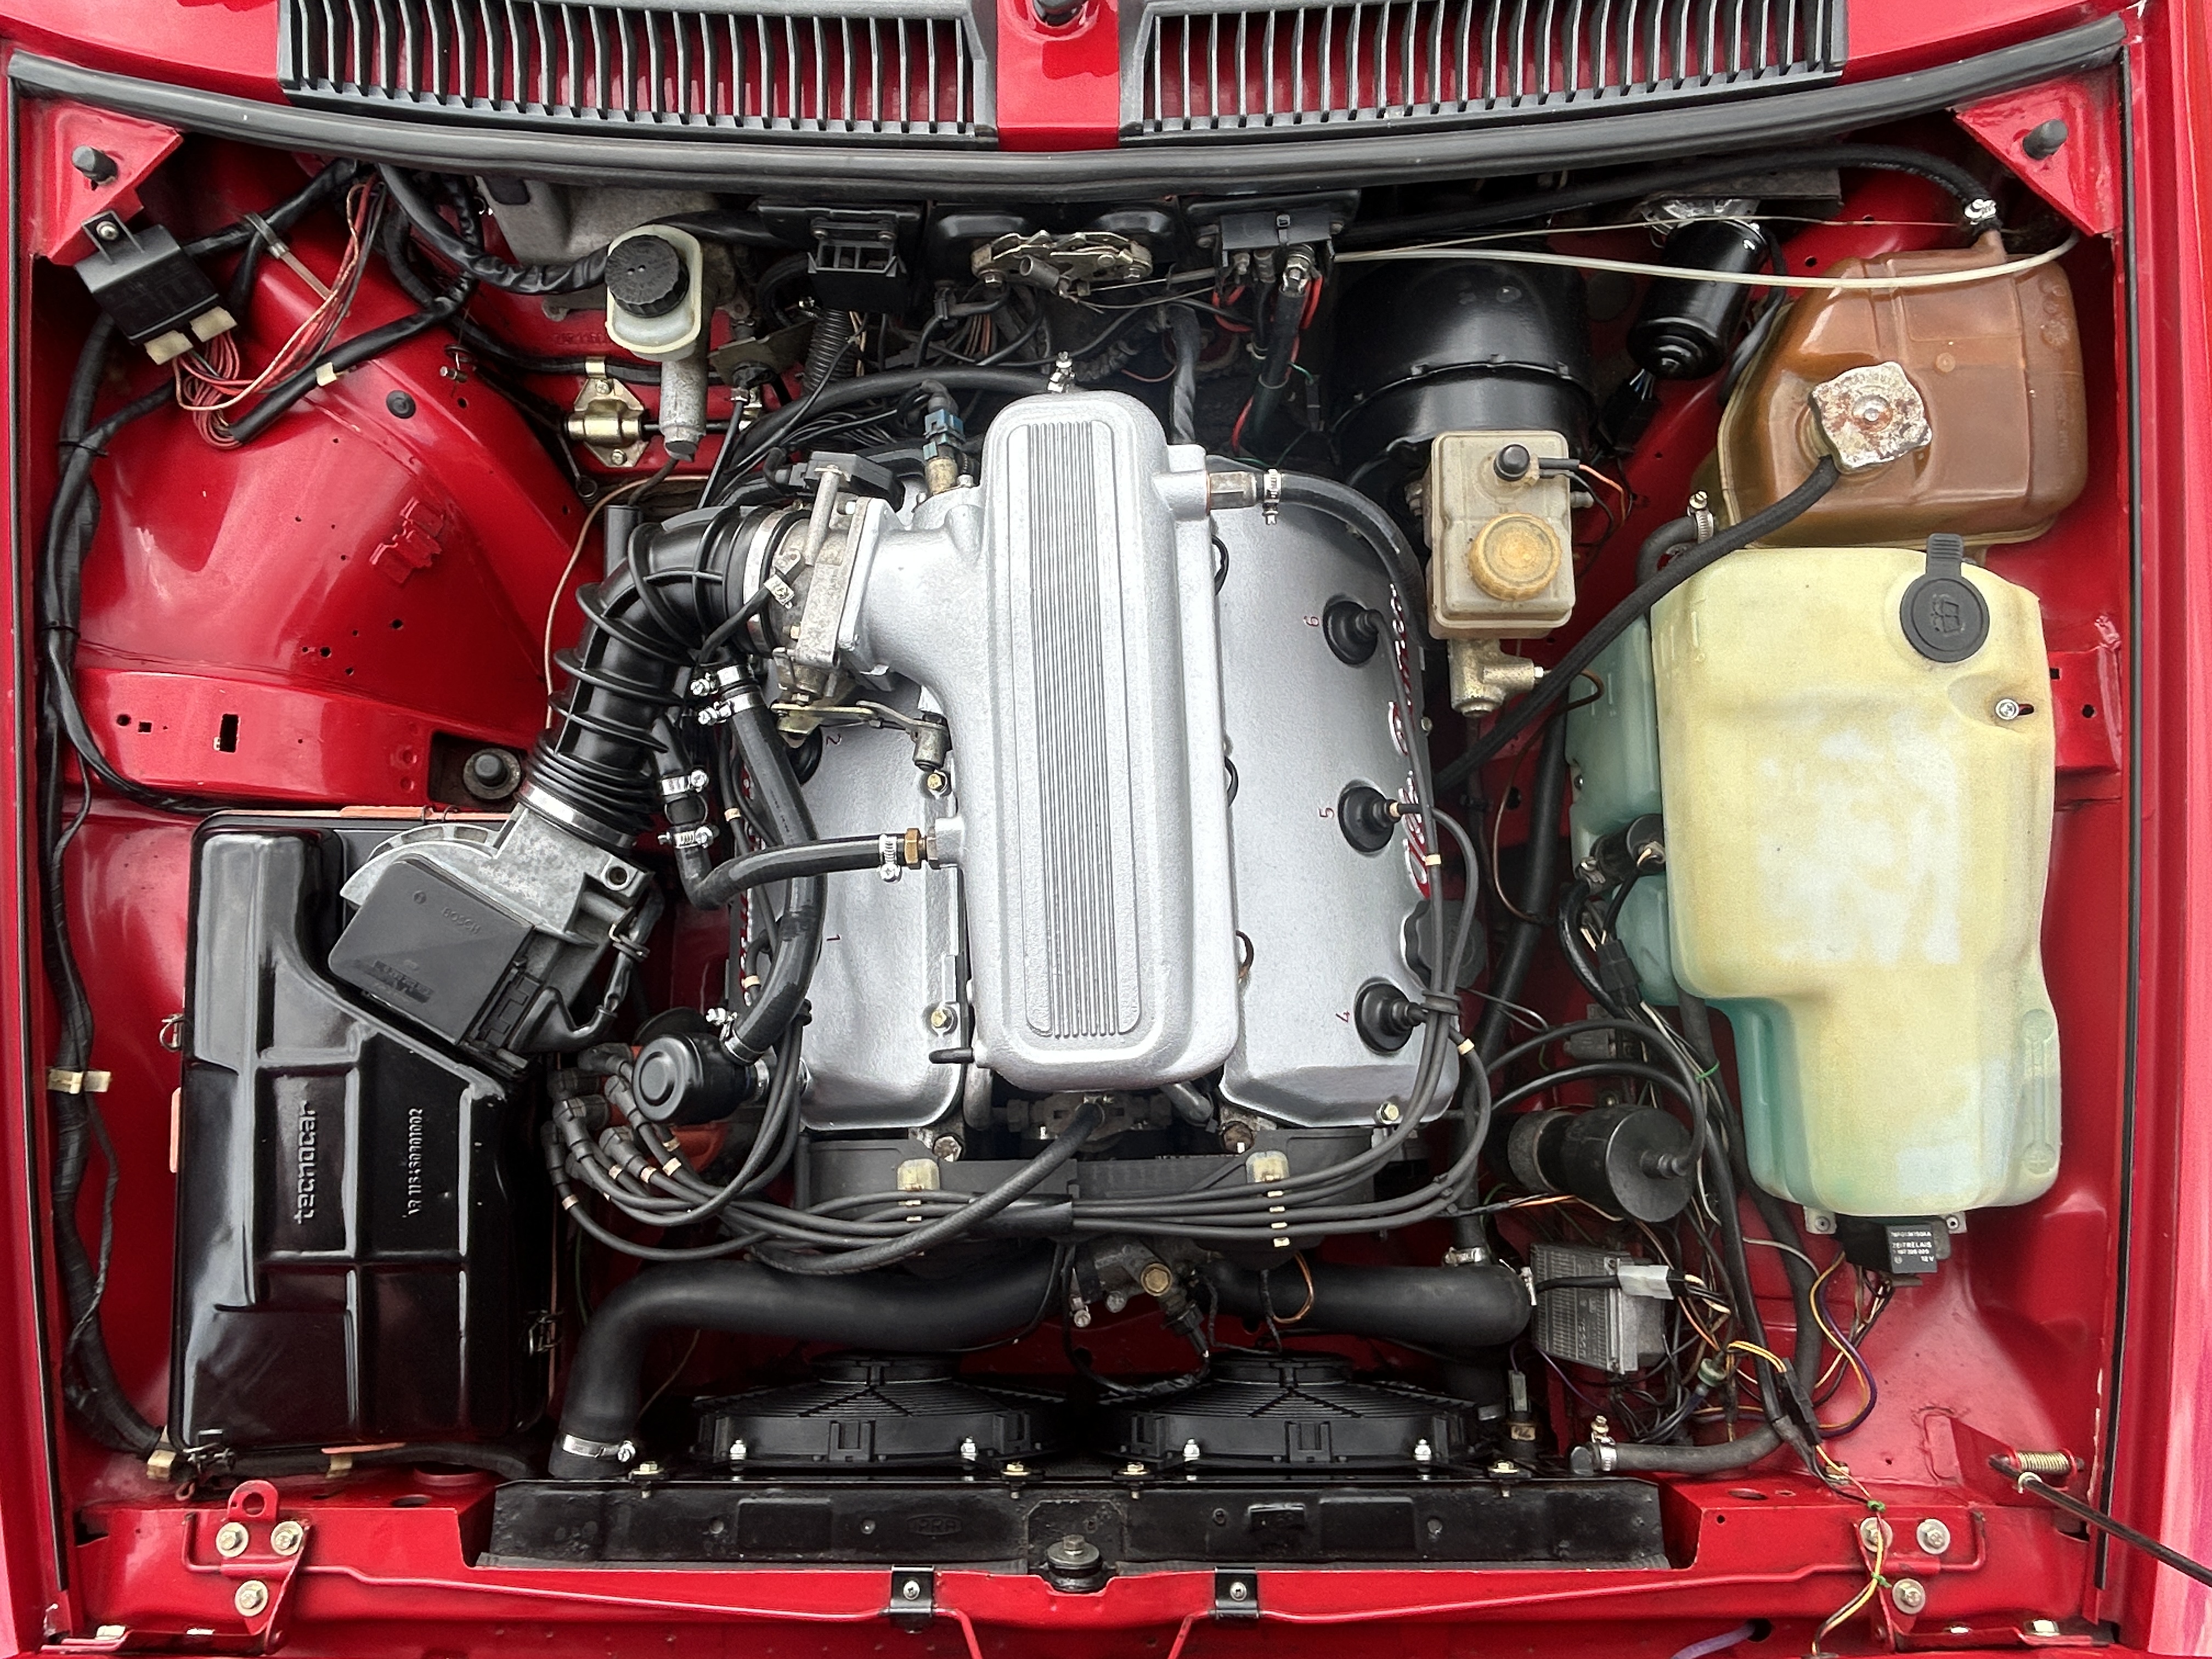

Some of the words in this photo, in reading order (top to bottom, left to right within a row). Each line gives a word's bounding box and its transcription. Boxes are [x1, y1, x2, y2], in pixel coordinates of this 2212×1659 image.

[1303, 615, 1320, 627] 6
[826, 733, 842, 746] 2
[1318, 806, 1335, 819] 5
[442, 906, 481, 934] BOSCH
[1335, 1011, 1350, 1023] 4
[293, 1099, 317, 1224] tecnocar
